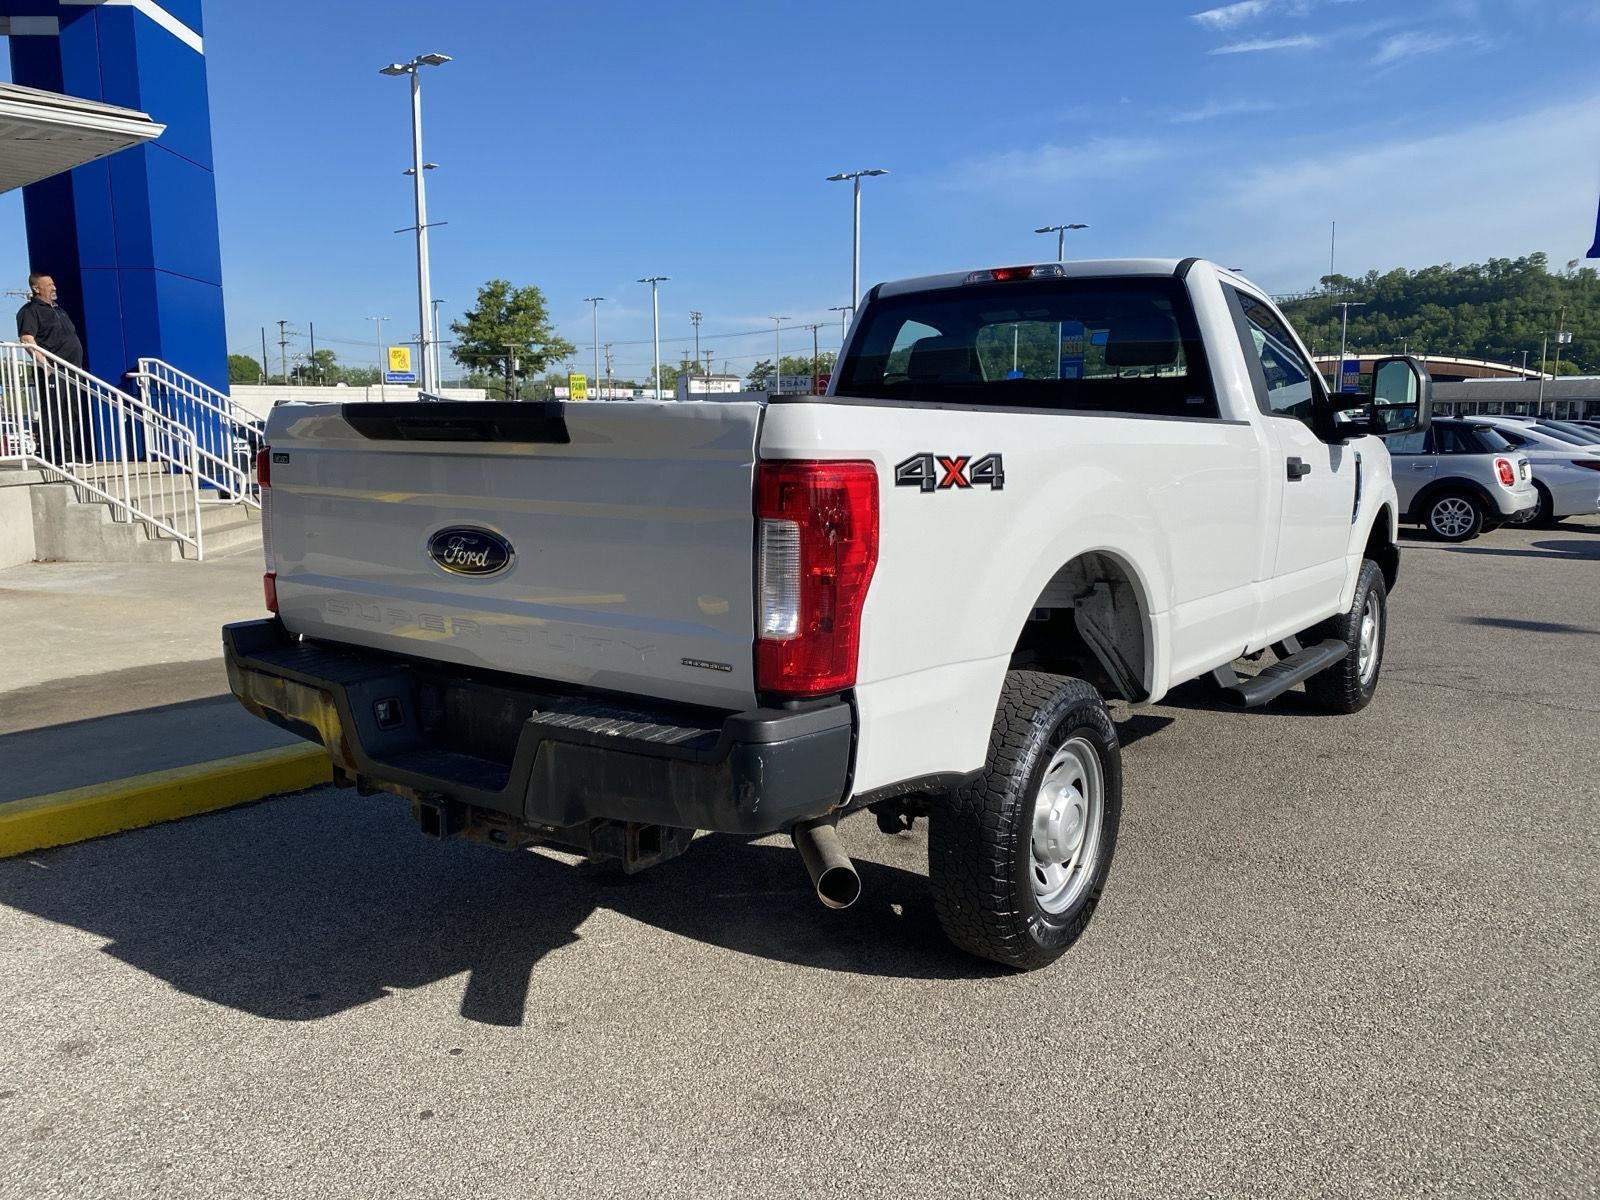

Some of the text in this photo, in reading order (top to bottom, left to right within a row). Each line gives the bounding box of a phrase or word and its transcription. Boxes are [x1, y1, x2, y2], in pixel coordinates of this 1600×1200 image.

[1062, 341, 1083, 353] USED
[443, 536, 490, 567] Ford
[321, 597, 656, 664] SUPER DUTY
